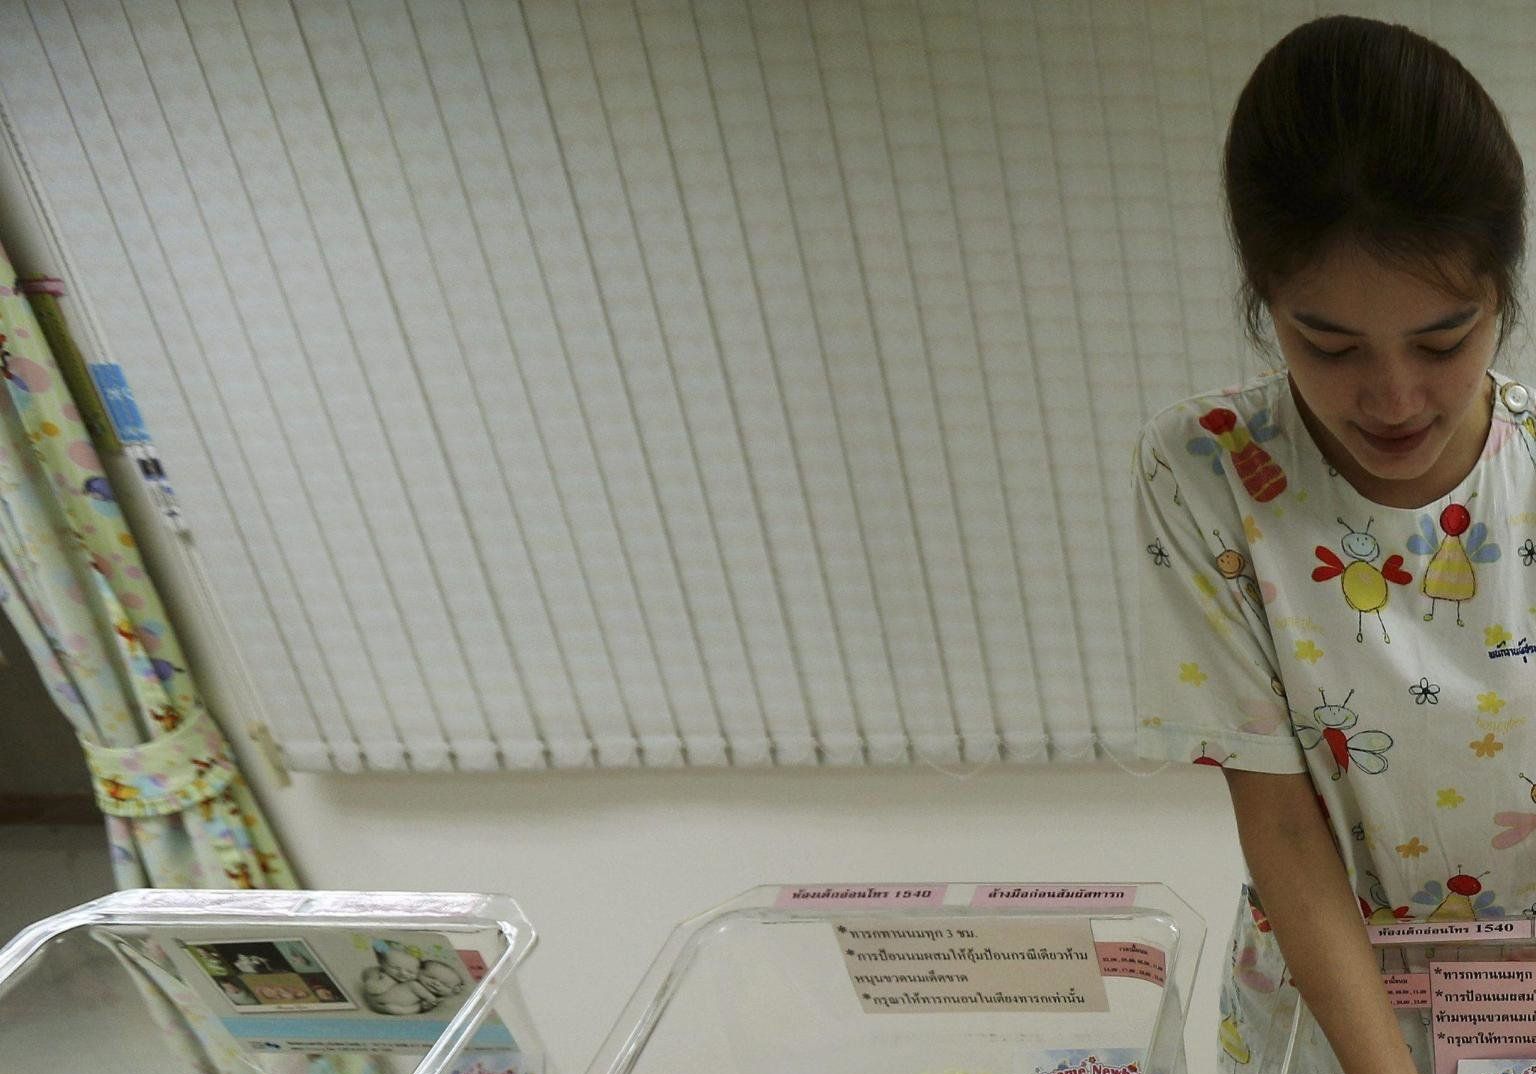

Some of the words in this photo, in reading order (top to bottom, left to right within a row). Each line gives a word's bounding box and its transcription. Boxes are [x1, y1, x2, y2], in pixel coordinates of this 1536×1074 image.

[894, 888, 932, 899] 1540
[946, 928, 954, 938] 3
[956, 928, 979, 939] ชม.
[1474, 922, 1514, 934] 1540
